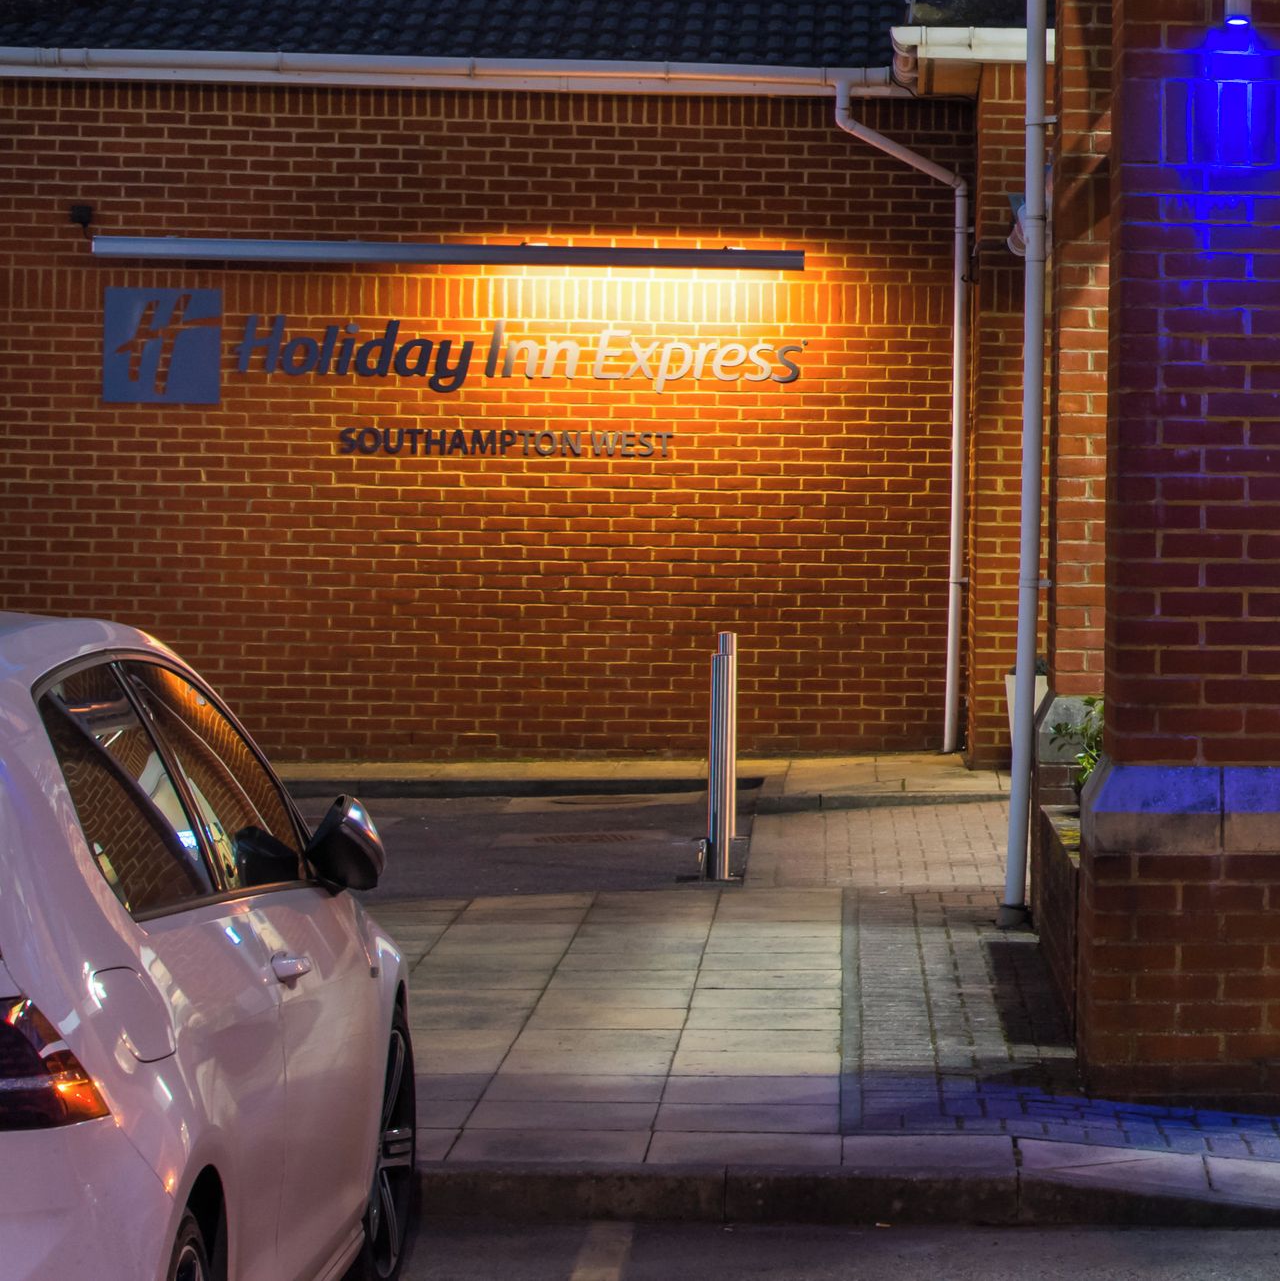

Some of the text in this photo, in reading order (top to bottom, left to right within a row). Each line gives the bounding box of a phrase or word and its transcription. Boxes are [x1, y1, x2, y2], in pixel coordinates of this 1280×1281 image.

[235, 314, 803, 394] Holiday Inn Express
[338, 427, 673, 457] SOUTHAMPTON WEST
